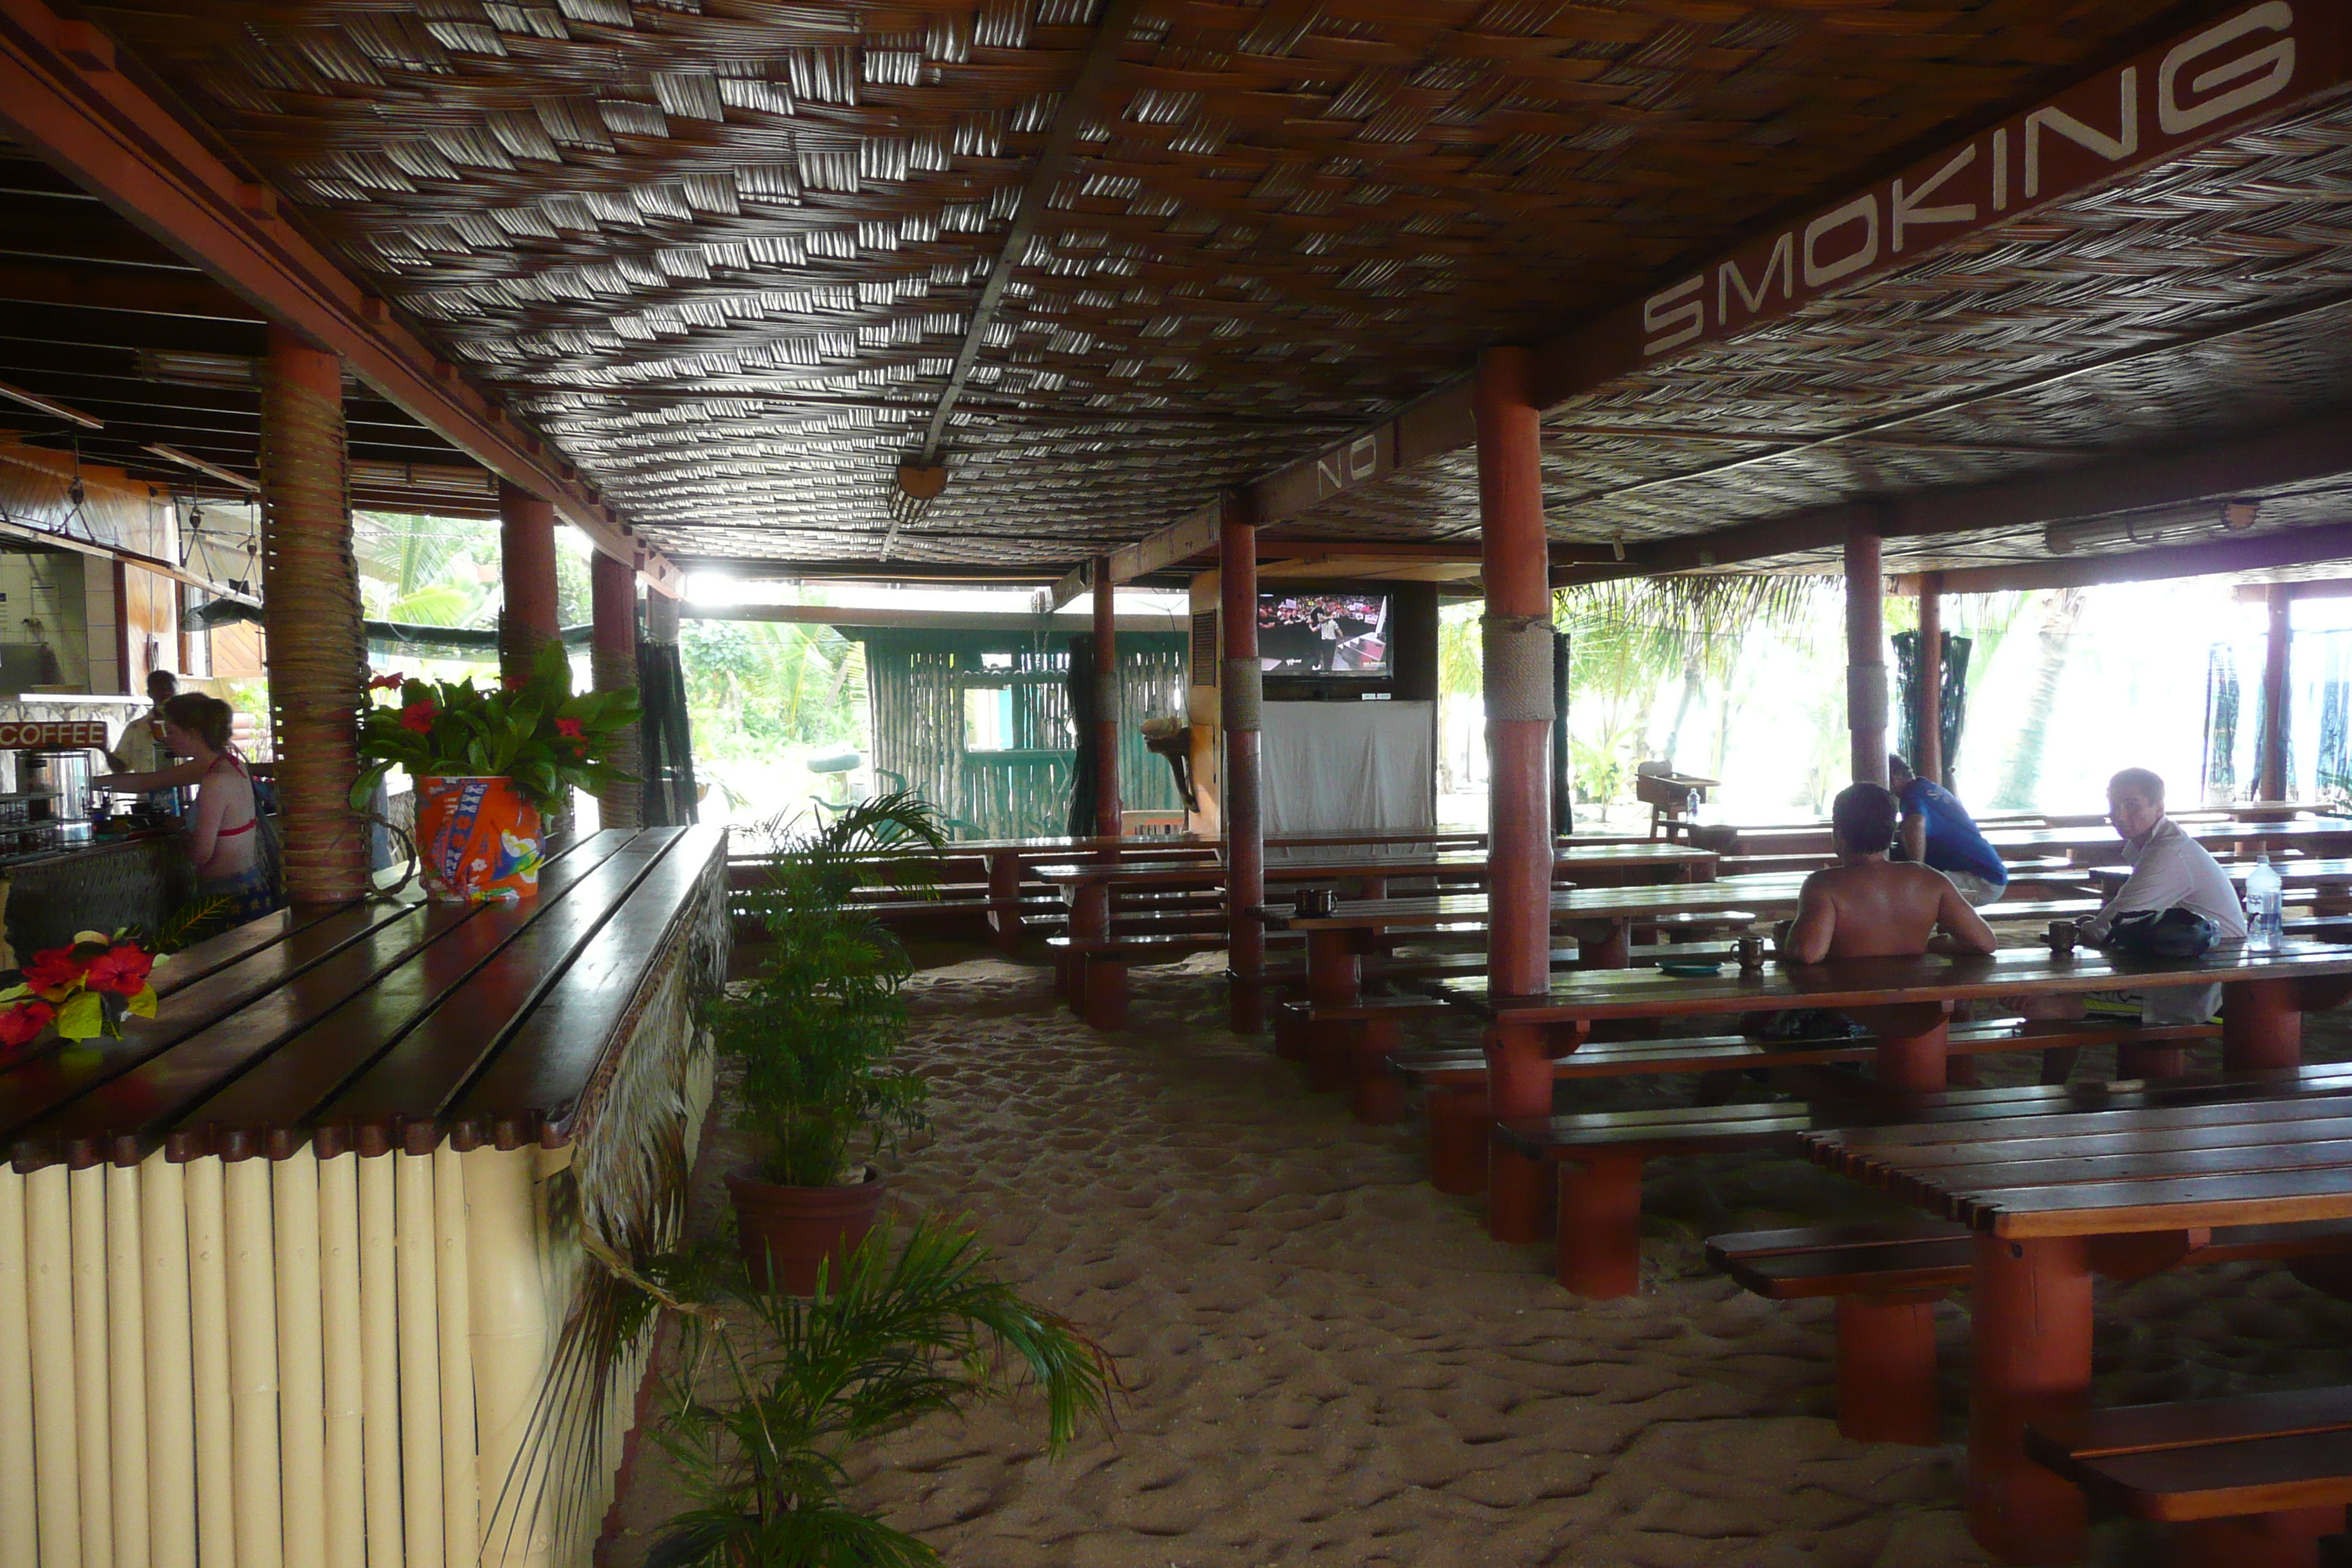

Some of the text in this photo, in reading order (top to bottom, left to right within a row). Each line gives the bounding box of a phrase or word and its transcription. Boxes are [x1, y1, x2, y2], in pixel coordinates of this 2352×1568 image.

[1317, 1, 2296, 497] NO SMOKING
[0, 723, 104, 745] COFFEE
